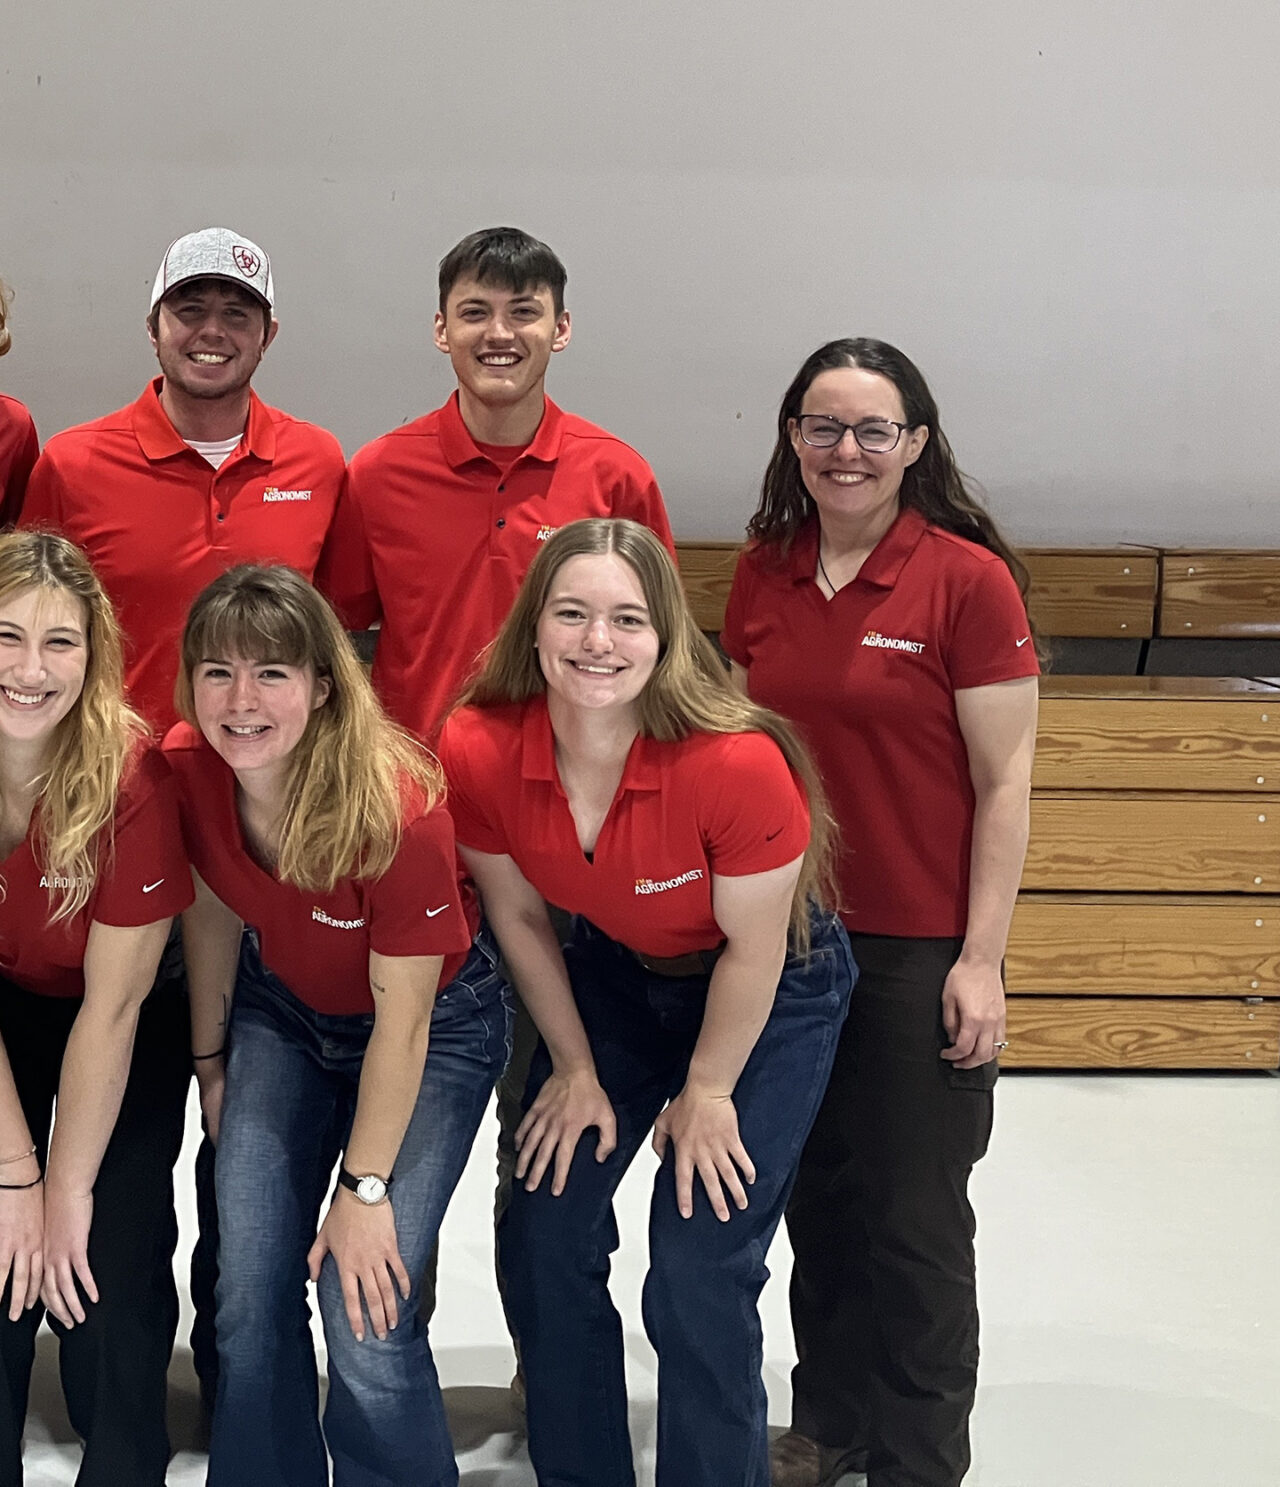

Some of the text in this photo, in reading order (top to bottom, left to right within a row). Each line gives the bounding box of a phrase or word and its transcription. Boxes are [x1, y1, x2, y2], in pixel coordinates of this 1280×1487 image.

[263, 490, 312, 502] AGRONOMIST
[861, 636, 926, 654] AGRONOMIST
[635, 869, 704, 895] AGRONOMIST
